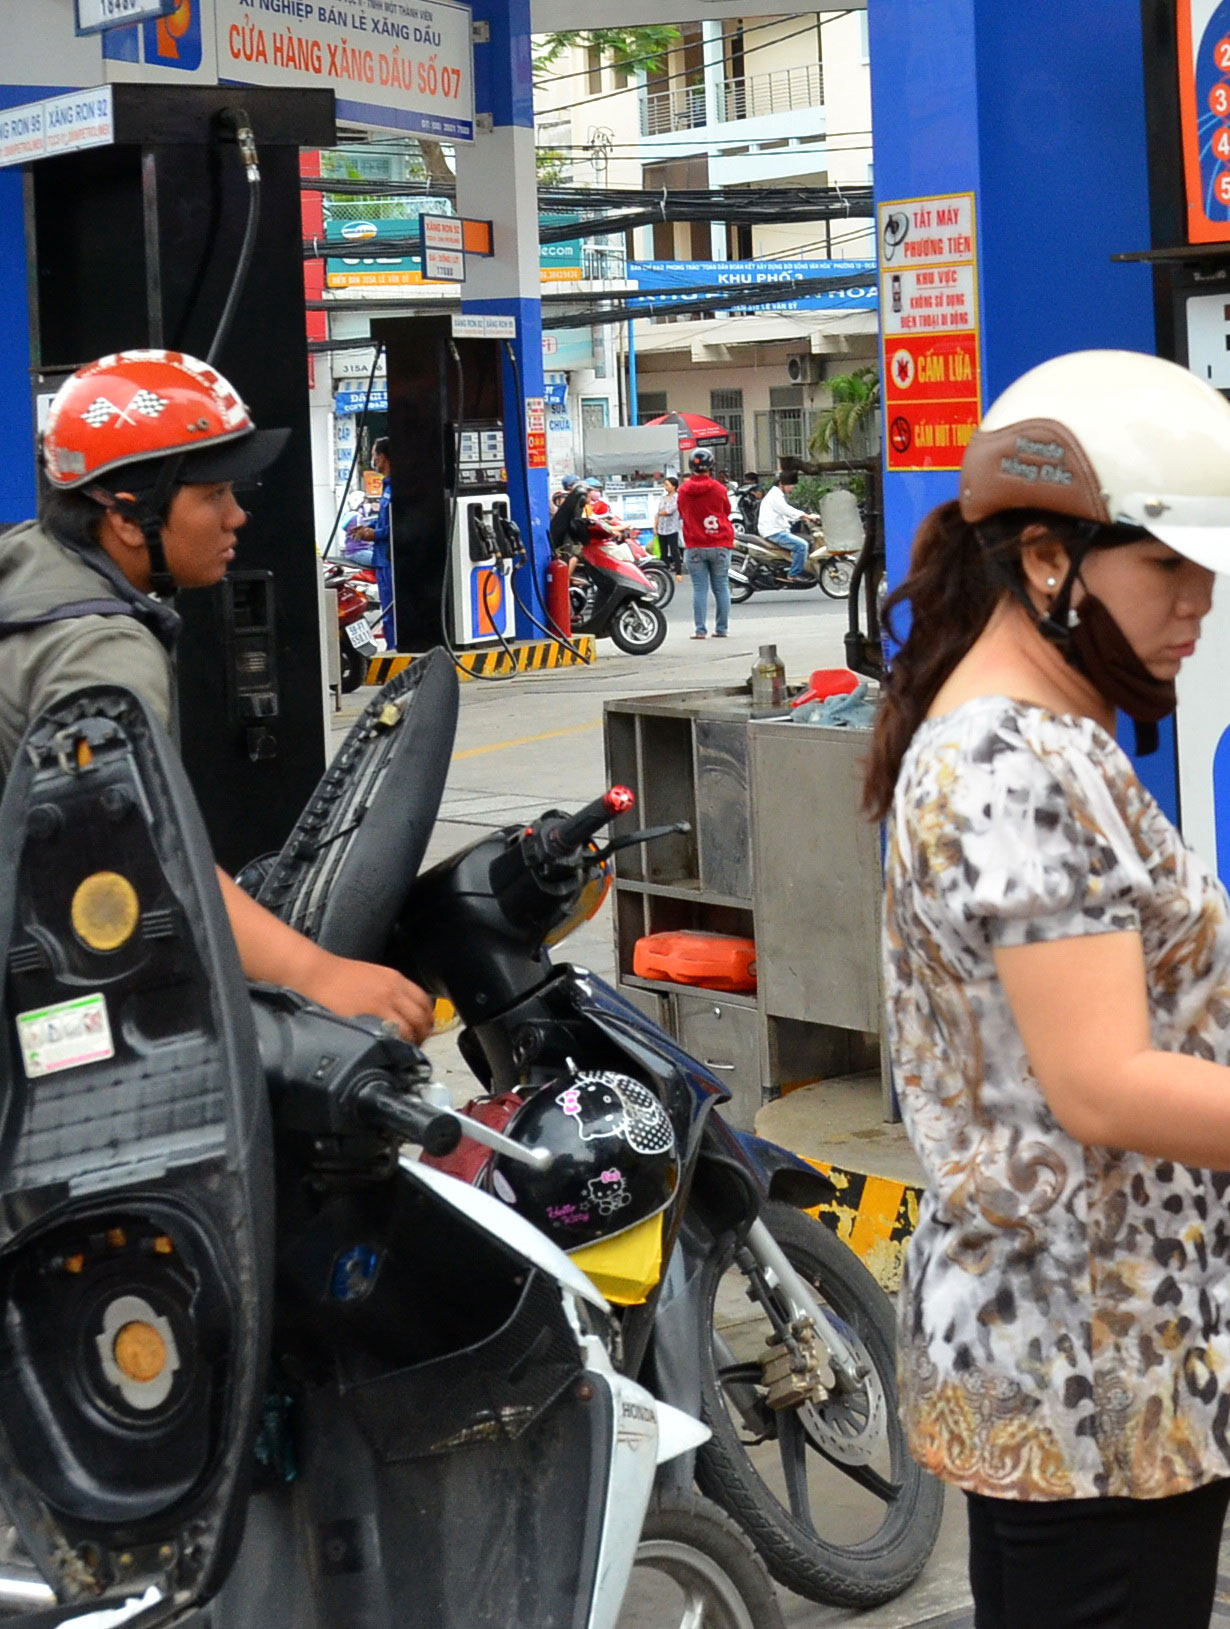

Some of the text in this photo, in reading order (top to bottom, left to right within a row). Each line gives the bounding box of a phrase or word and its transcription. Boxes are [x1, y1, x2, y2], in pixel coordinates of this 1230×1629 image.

[318, 5, 347, 27] BÁN
[371, 16, 410, 40] XĂNG
[228, 13, 461, 100] CỬA HÀNG XĂNG DẦU SỐ 07
[1215, 89, 1228, 112] 3
[48, 98, 108, 128] XĂNG RON 92
[11, 118, 30, 137] RON
[1217, 132, 1230, 154] 4
[913, 205, 960, 228] TẮT MÁY
[541, 247, 573, 256] ecom
[904, 234, 971, 258] PHƯƠNG TIỆN
[718, 274, 752, 284] KHU
[756, 270, 793, 282] PHỐ
[916, 270, 957, 286] KHU VỰC
[910, 294, 932, 309] KHÔNG
[946, 293, 964, 308] DỤNG
[918, 347, 972, 383] CẤM LỬA
[914, 419, 933, 448] CẤM
[622, 1402, 657, 1424] HONDA
